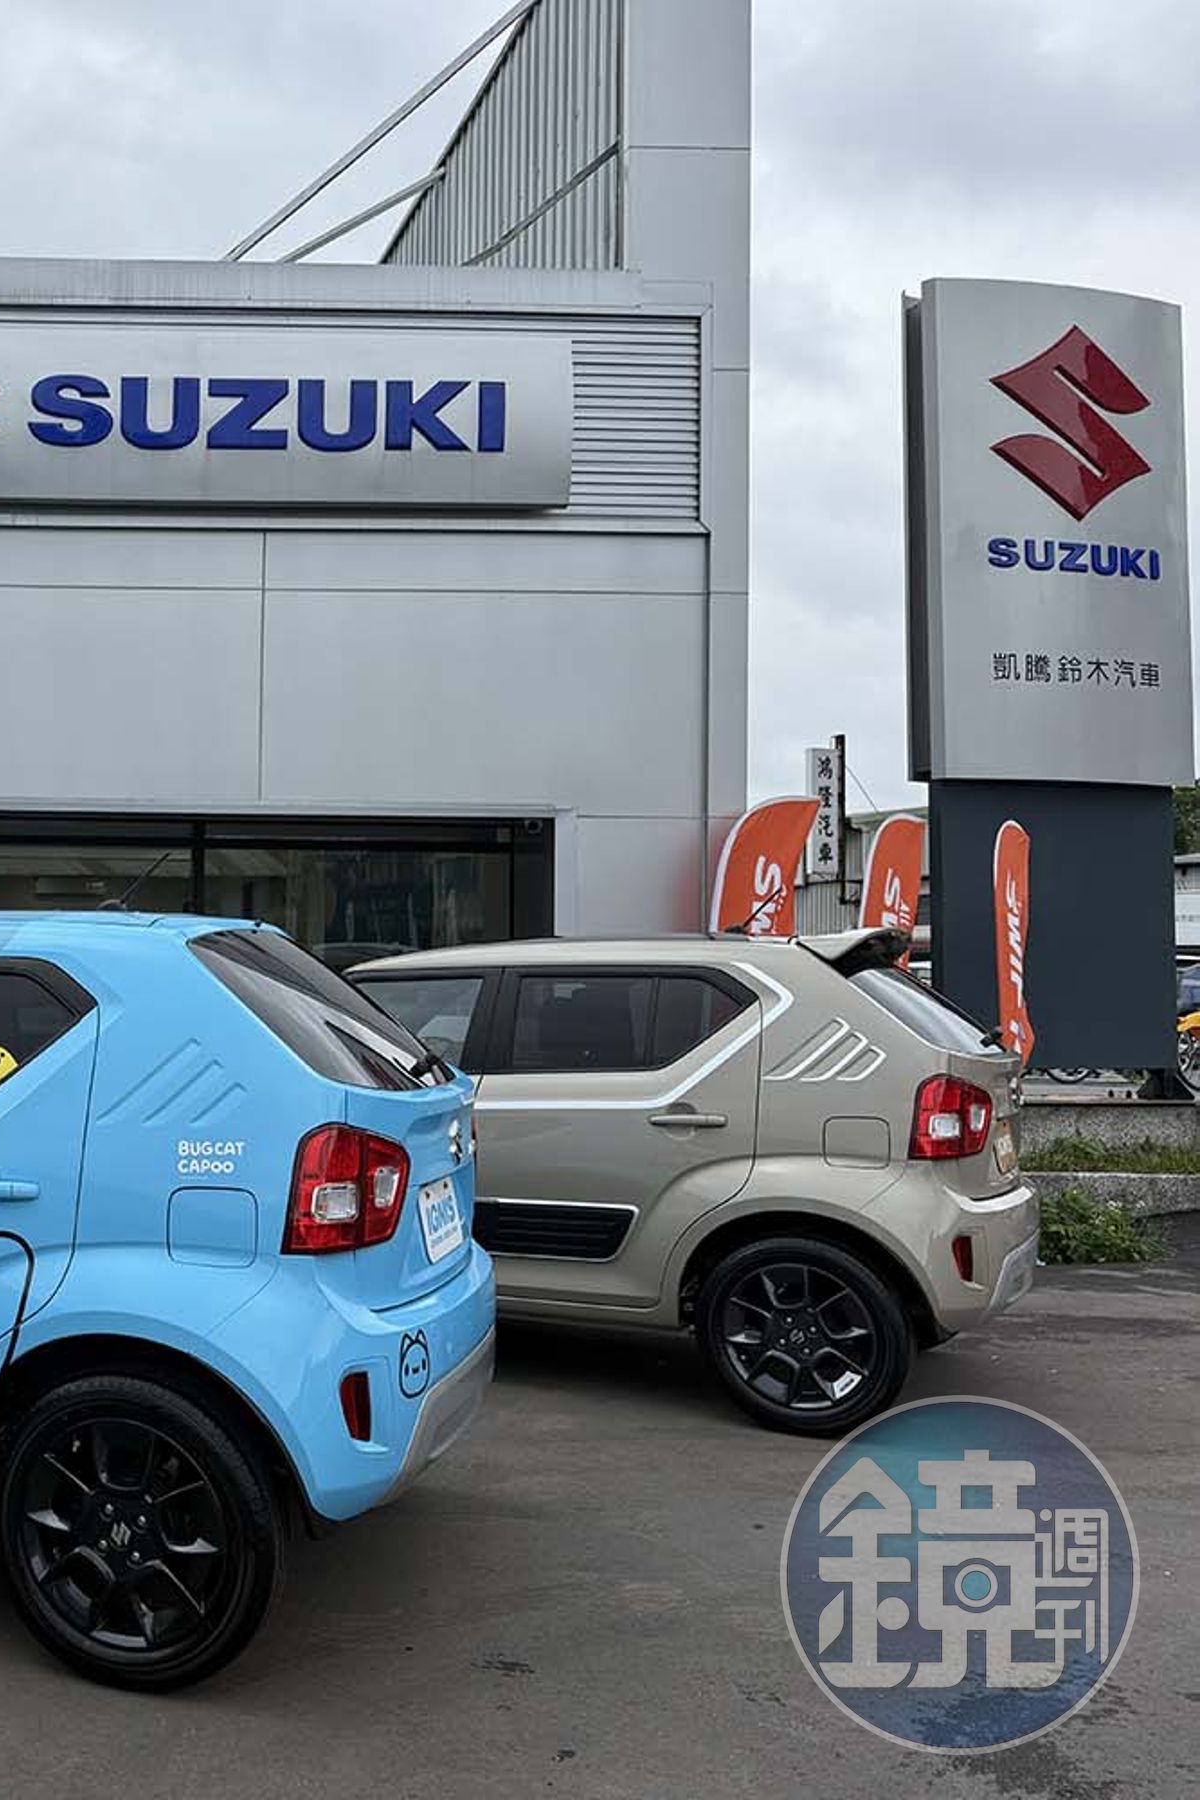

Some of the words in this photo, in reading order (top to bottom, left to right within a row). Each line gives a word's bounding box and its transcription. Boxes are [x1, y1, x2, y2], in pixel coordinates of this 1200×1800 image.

[28, 374, 506, 452] SUZUKI
[987, 537, 1161, 581] SUZUKI
[992, 652, 1161, 688] 凱騰鈴木汽車
[178, 1159, 234, 1173] CAPOO
